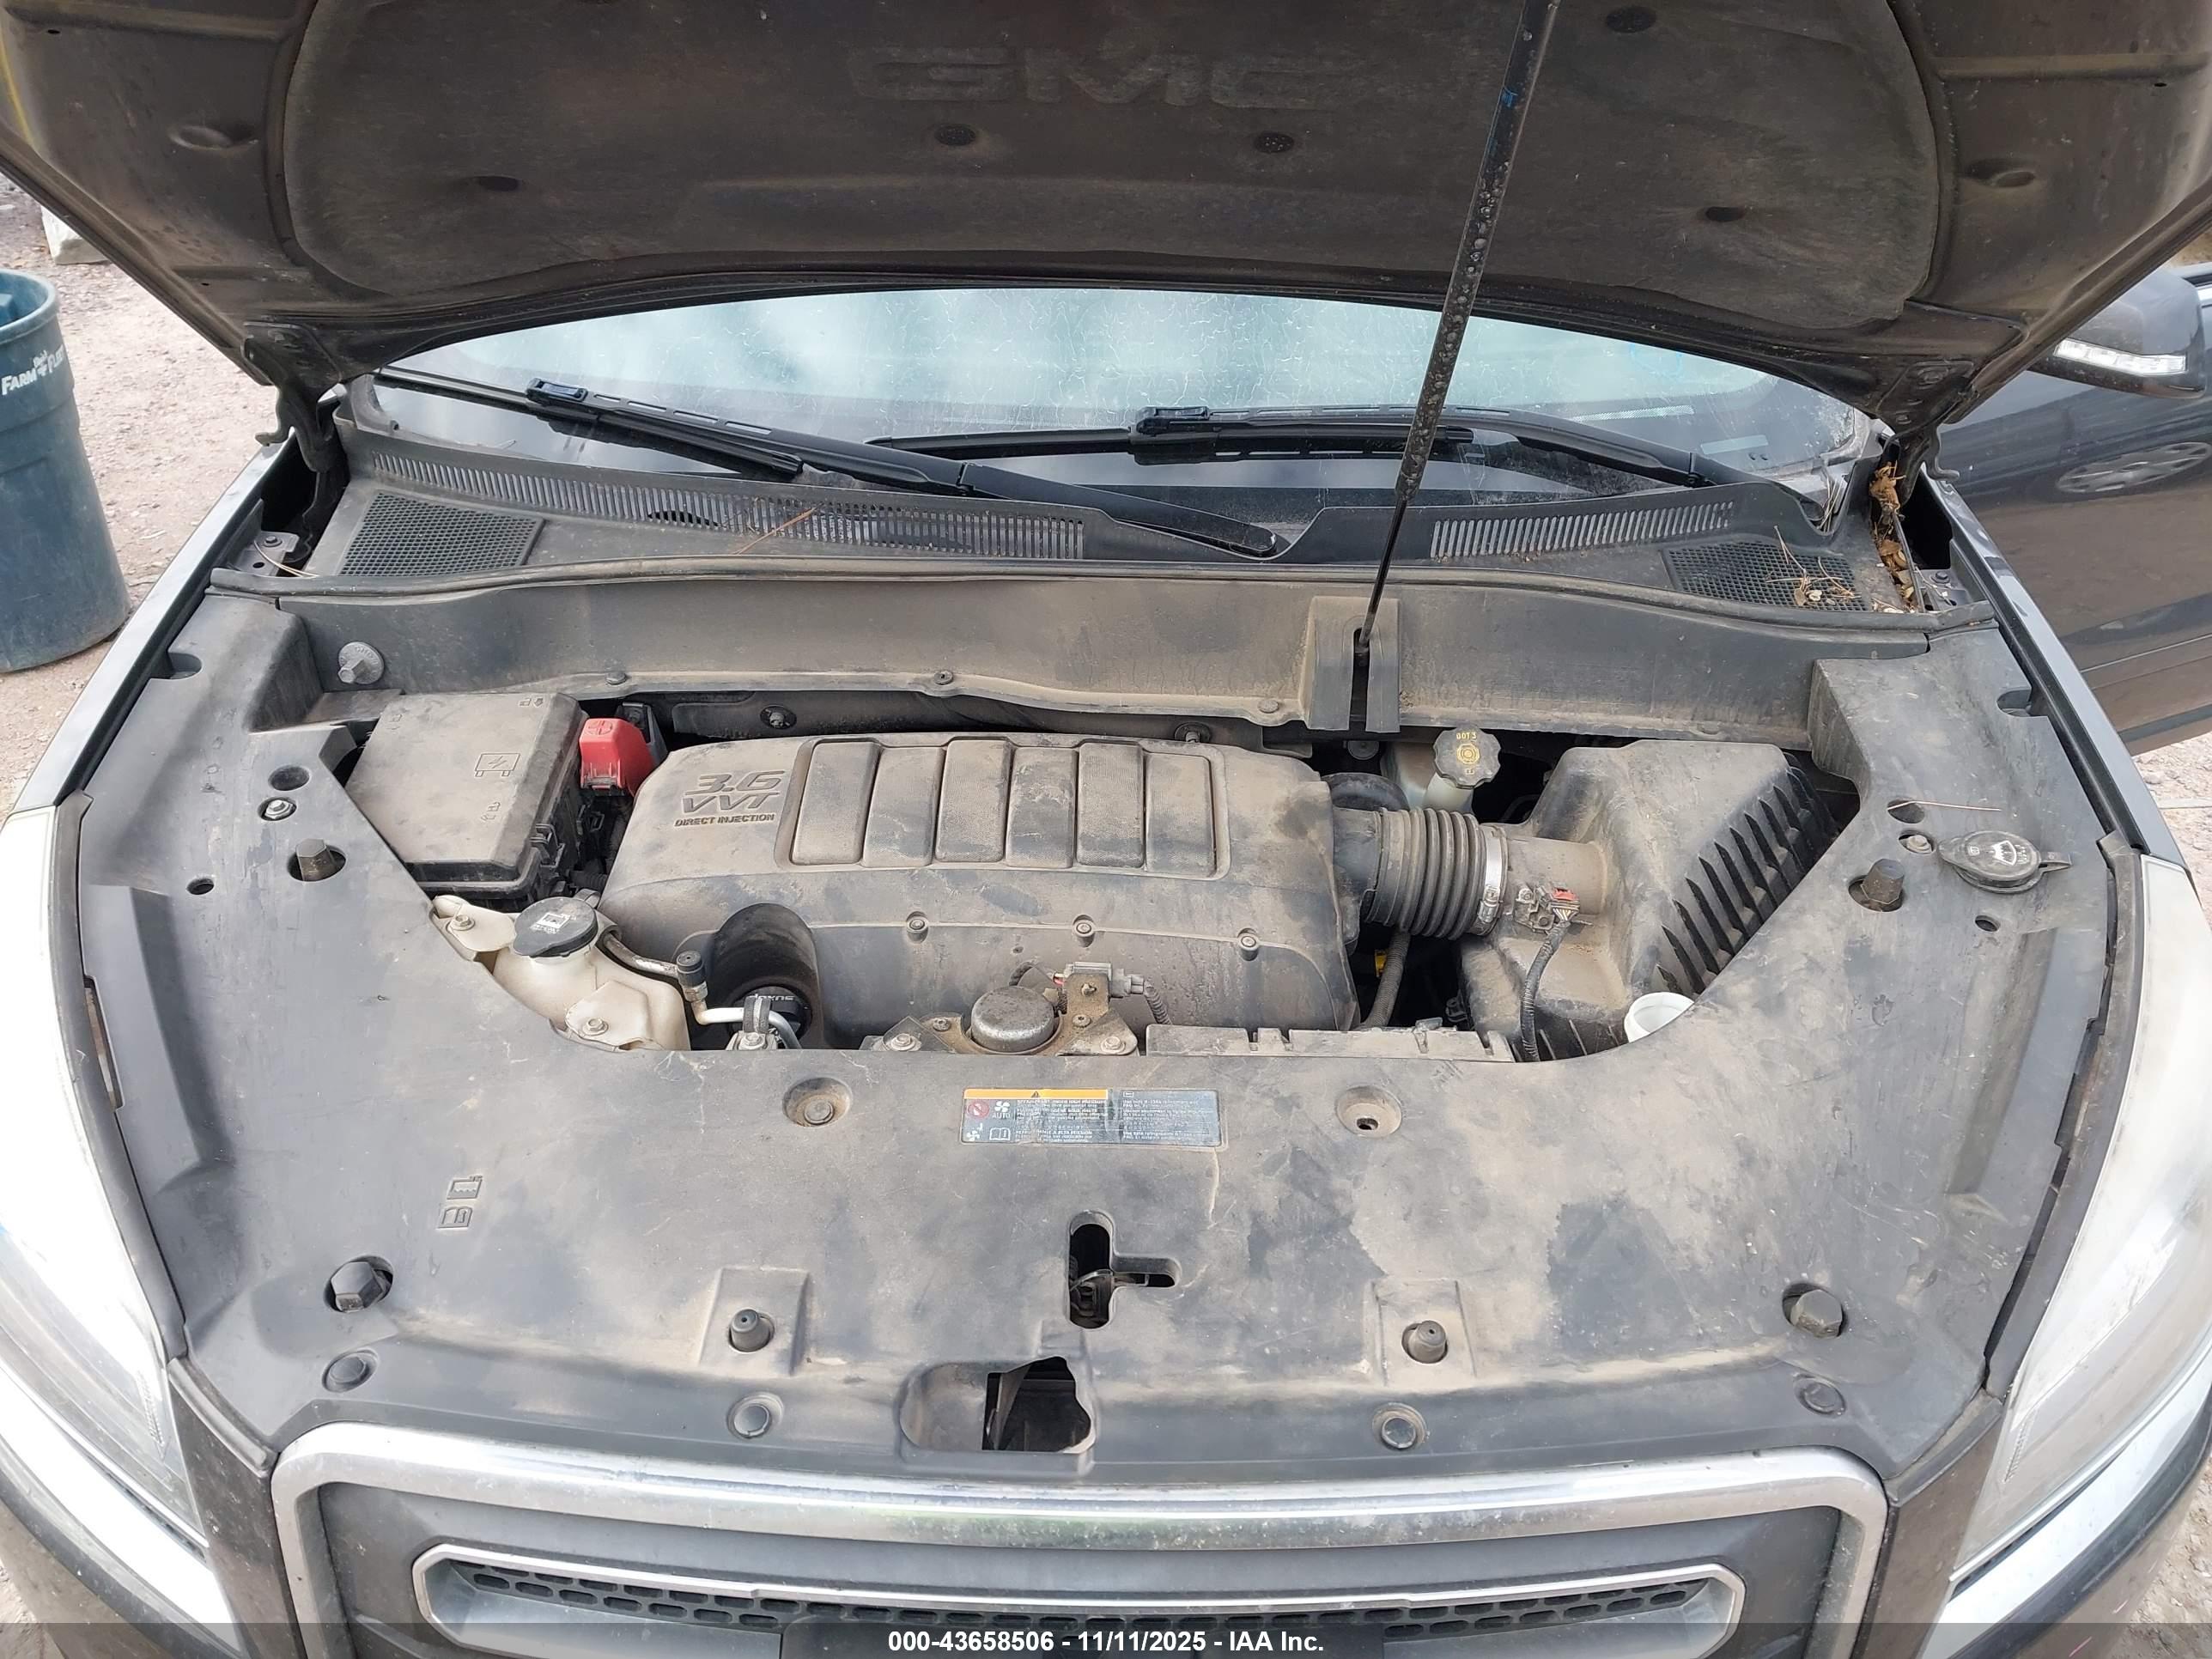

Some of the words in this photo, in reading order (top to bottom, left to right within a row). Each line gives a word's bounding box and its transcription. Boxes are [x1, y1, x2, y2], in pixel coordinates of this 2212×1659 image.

[848, 46, 1374, 112] GMC
[1, 368, 38, 396] FARM
[685, 770, 786, 796] 3.6
[683, 792, 780, 813] VVT
[674, 817, 716, 827] DIRECT
[717, 813, 775, 825] INJECTION
